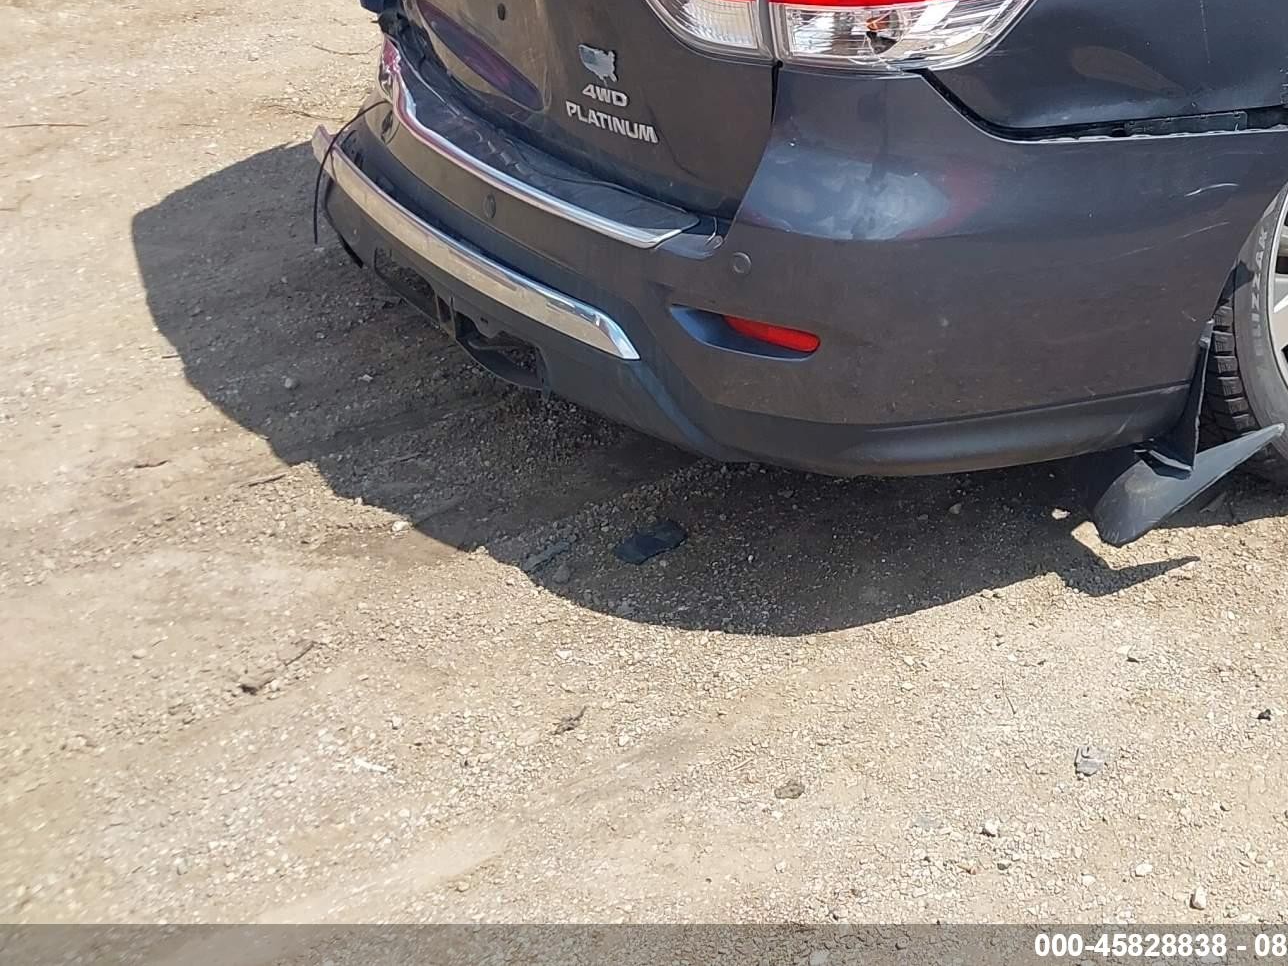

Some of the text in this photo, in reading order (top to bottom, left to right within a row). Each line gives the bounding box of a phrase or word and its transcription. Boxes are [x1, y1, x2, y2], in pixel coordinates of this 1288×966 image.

[582, 83, 628, 107] 4WD
[565, 100, 659, 144] PLATINUM
[1251, 225, 1268, 356] BLIZZAK
